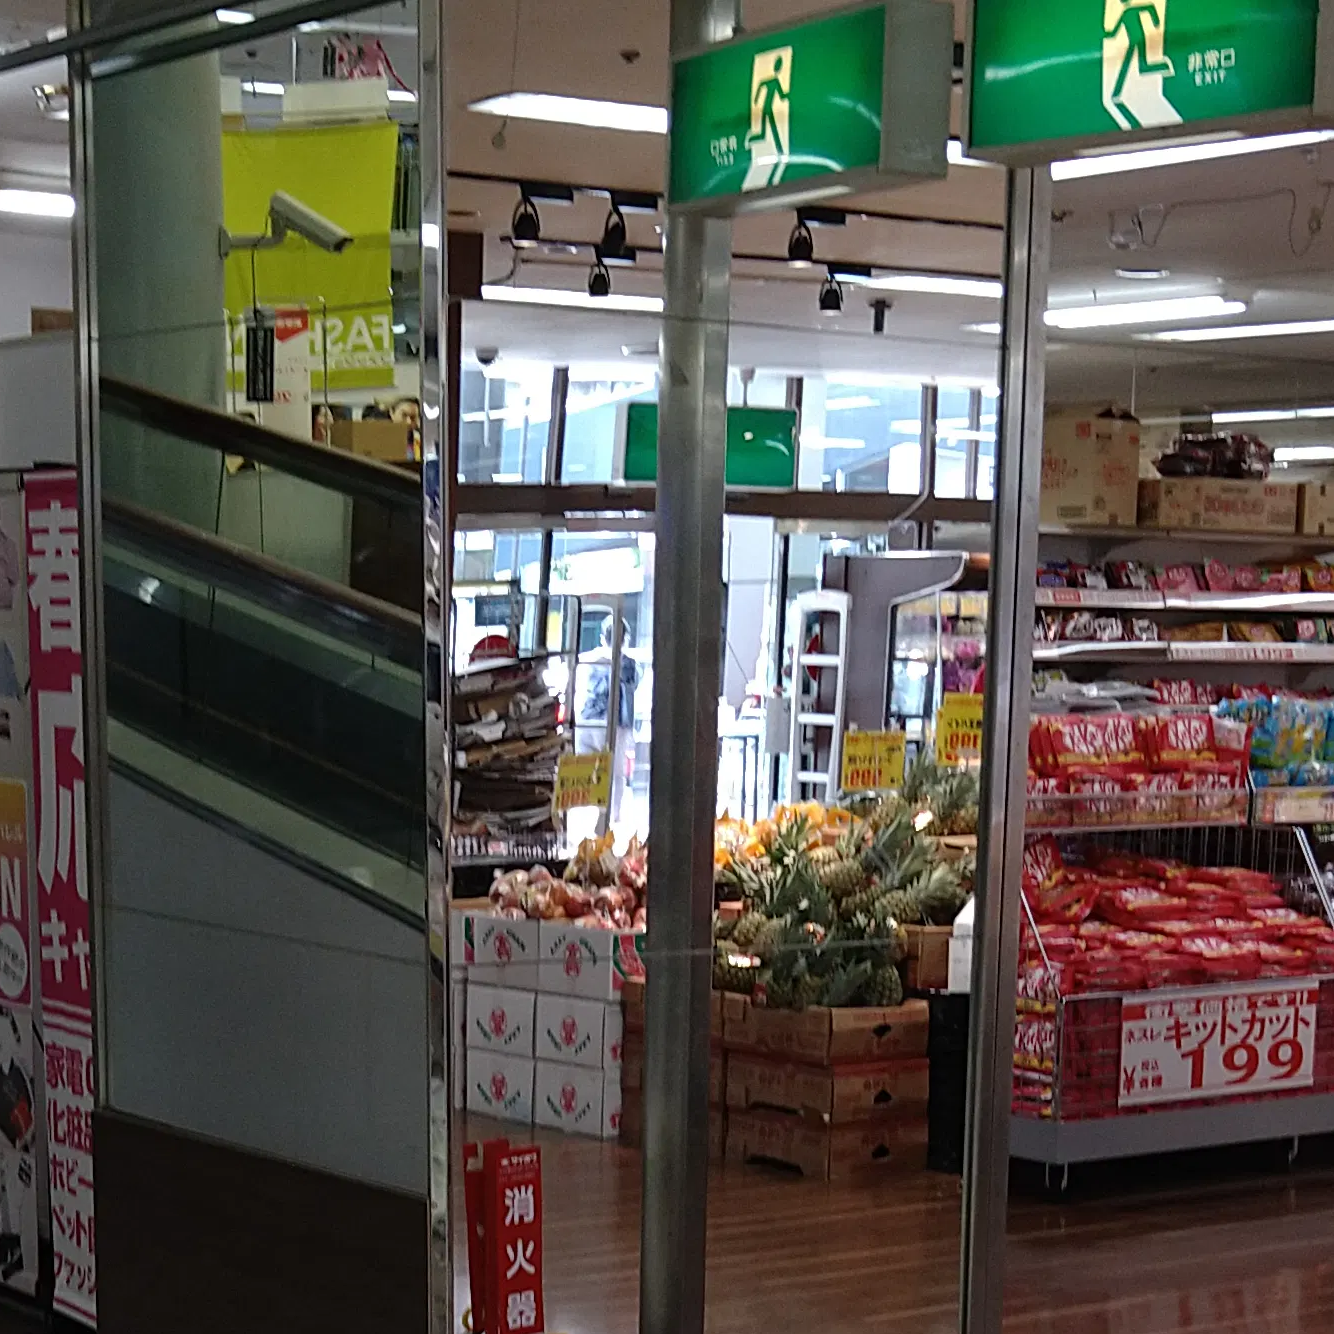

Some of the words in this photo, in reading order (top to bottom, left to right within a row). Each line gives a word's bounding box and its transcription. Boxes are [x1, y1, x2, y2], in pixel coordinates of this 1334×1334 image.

[1188, 47, 1235, 73] 非常口
[1194, 69, 1226, 87] EXIT
[1164, 1005, 1312, 1050] キットカット
[1181, 1038, 1304, 1089] 199
[504, 1185, 536, 1330] 消火器
